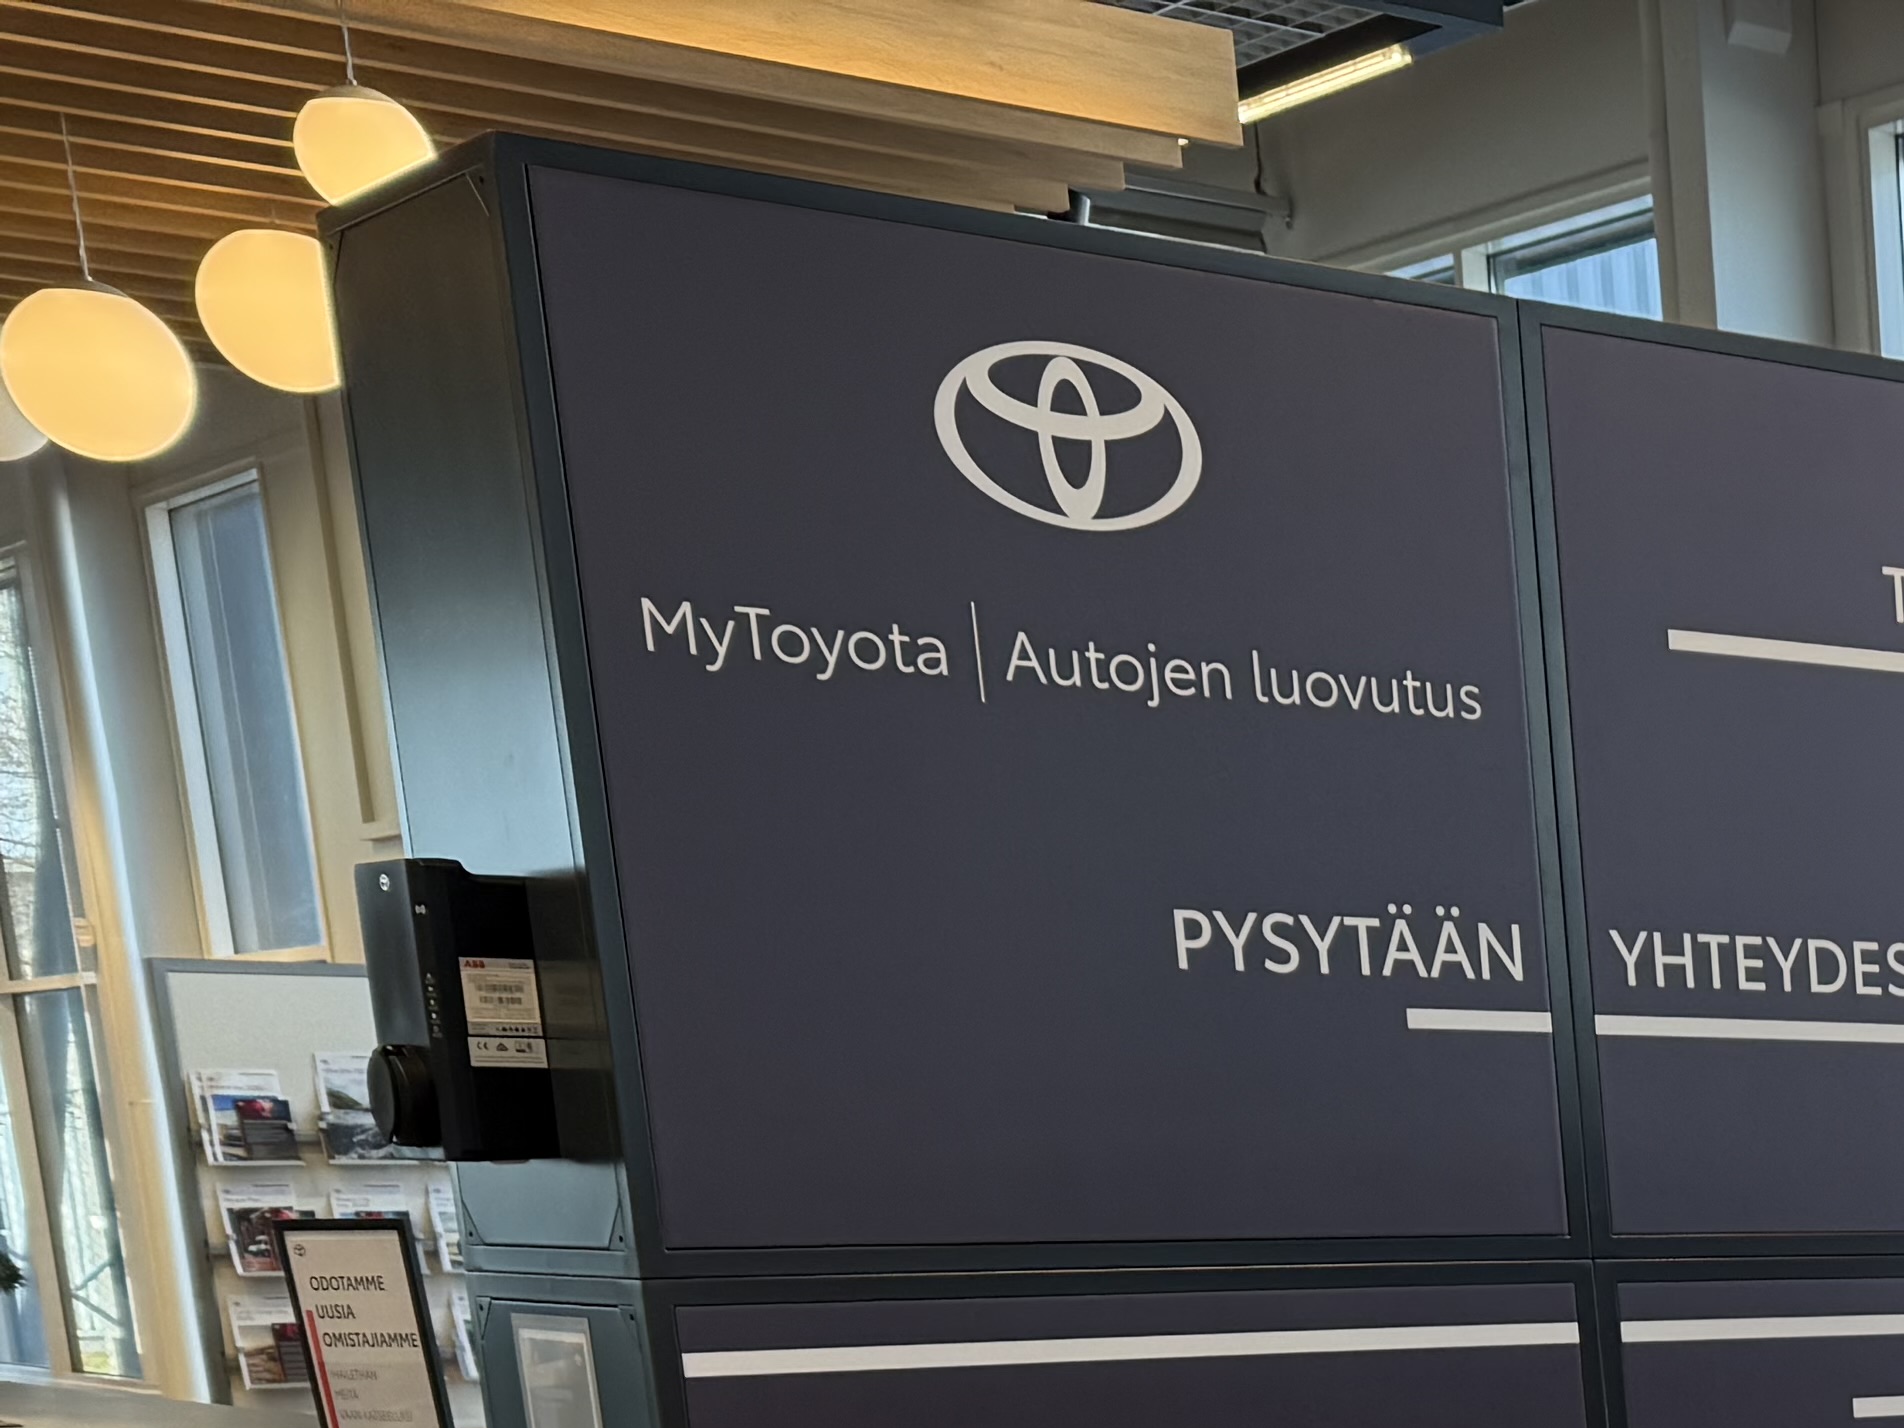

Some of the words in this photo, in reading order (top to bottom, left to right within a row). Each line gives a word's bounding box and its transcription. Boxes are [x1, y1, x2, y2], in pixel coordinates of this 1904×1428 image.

[640, 597, 949, 681] MyToyota
[1006, 631, 1232, 707] Autojen
[1252, 650, 1482, 720] luovutus
[1173, 903, 1524, 982] PYSYTÄÄN
[463, 960, 486, 969] ABB
[309, 1275, 386, 1292] ODOTAMME
[315, 1304, 356, 1319] UUSIA
[322, 1331, 419, 1349] OMISTAJIAMME
